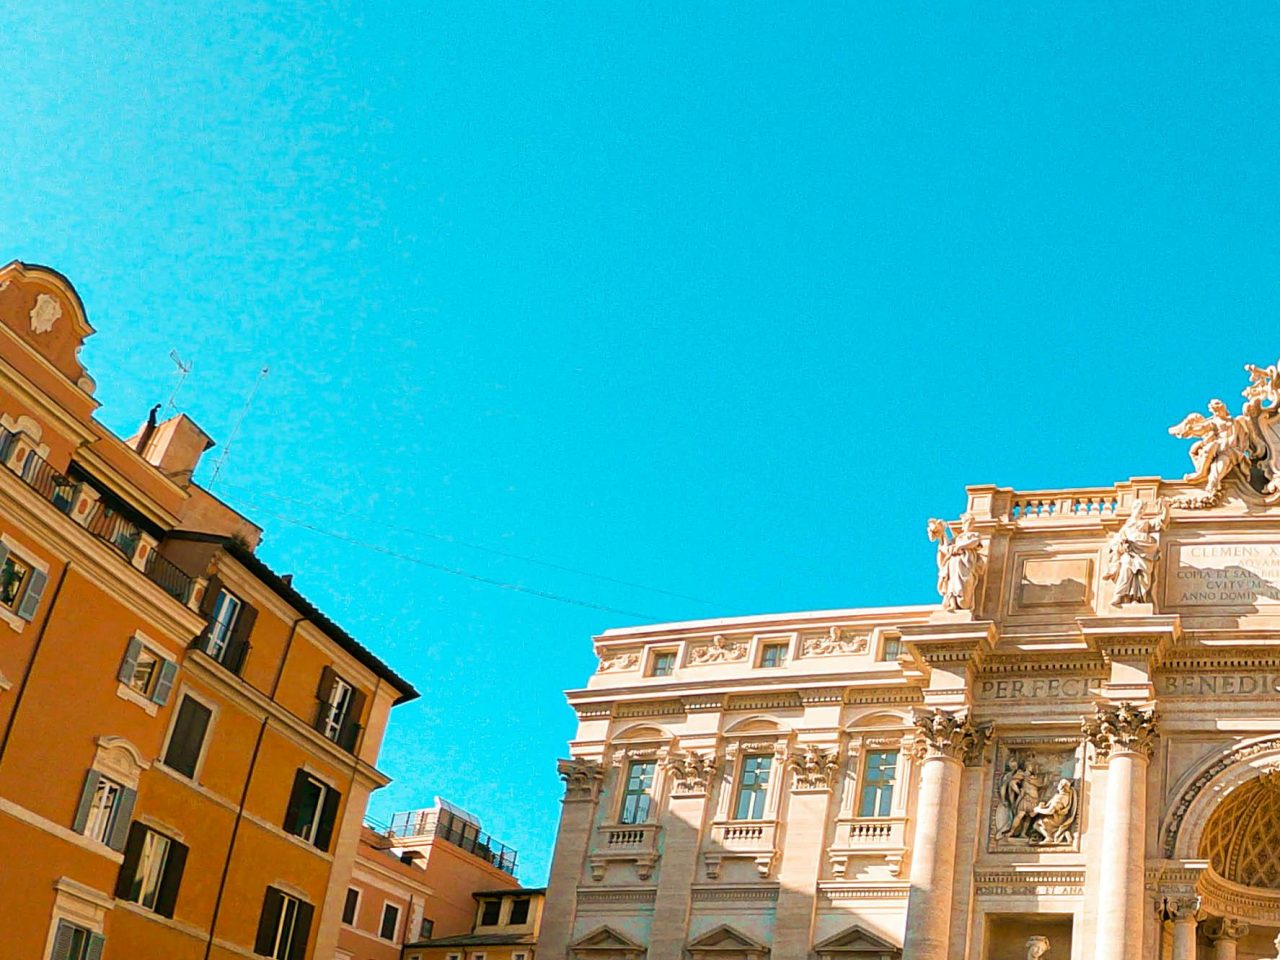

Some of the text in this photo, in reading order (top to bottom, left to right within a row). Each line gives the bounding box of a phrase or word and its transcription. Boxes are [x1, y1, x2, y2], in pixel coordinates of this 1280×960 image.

[1190, 546, 1260, 558] CLEMENS
[1180, 591, 1216, 601] ANNO
[979, 677, 1109, 700] PERFECIT
